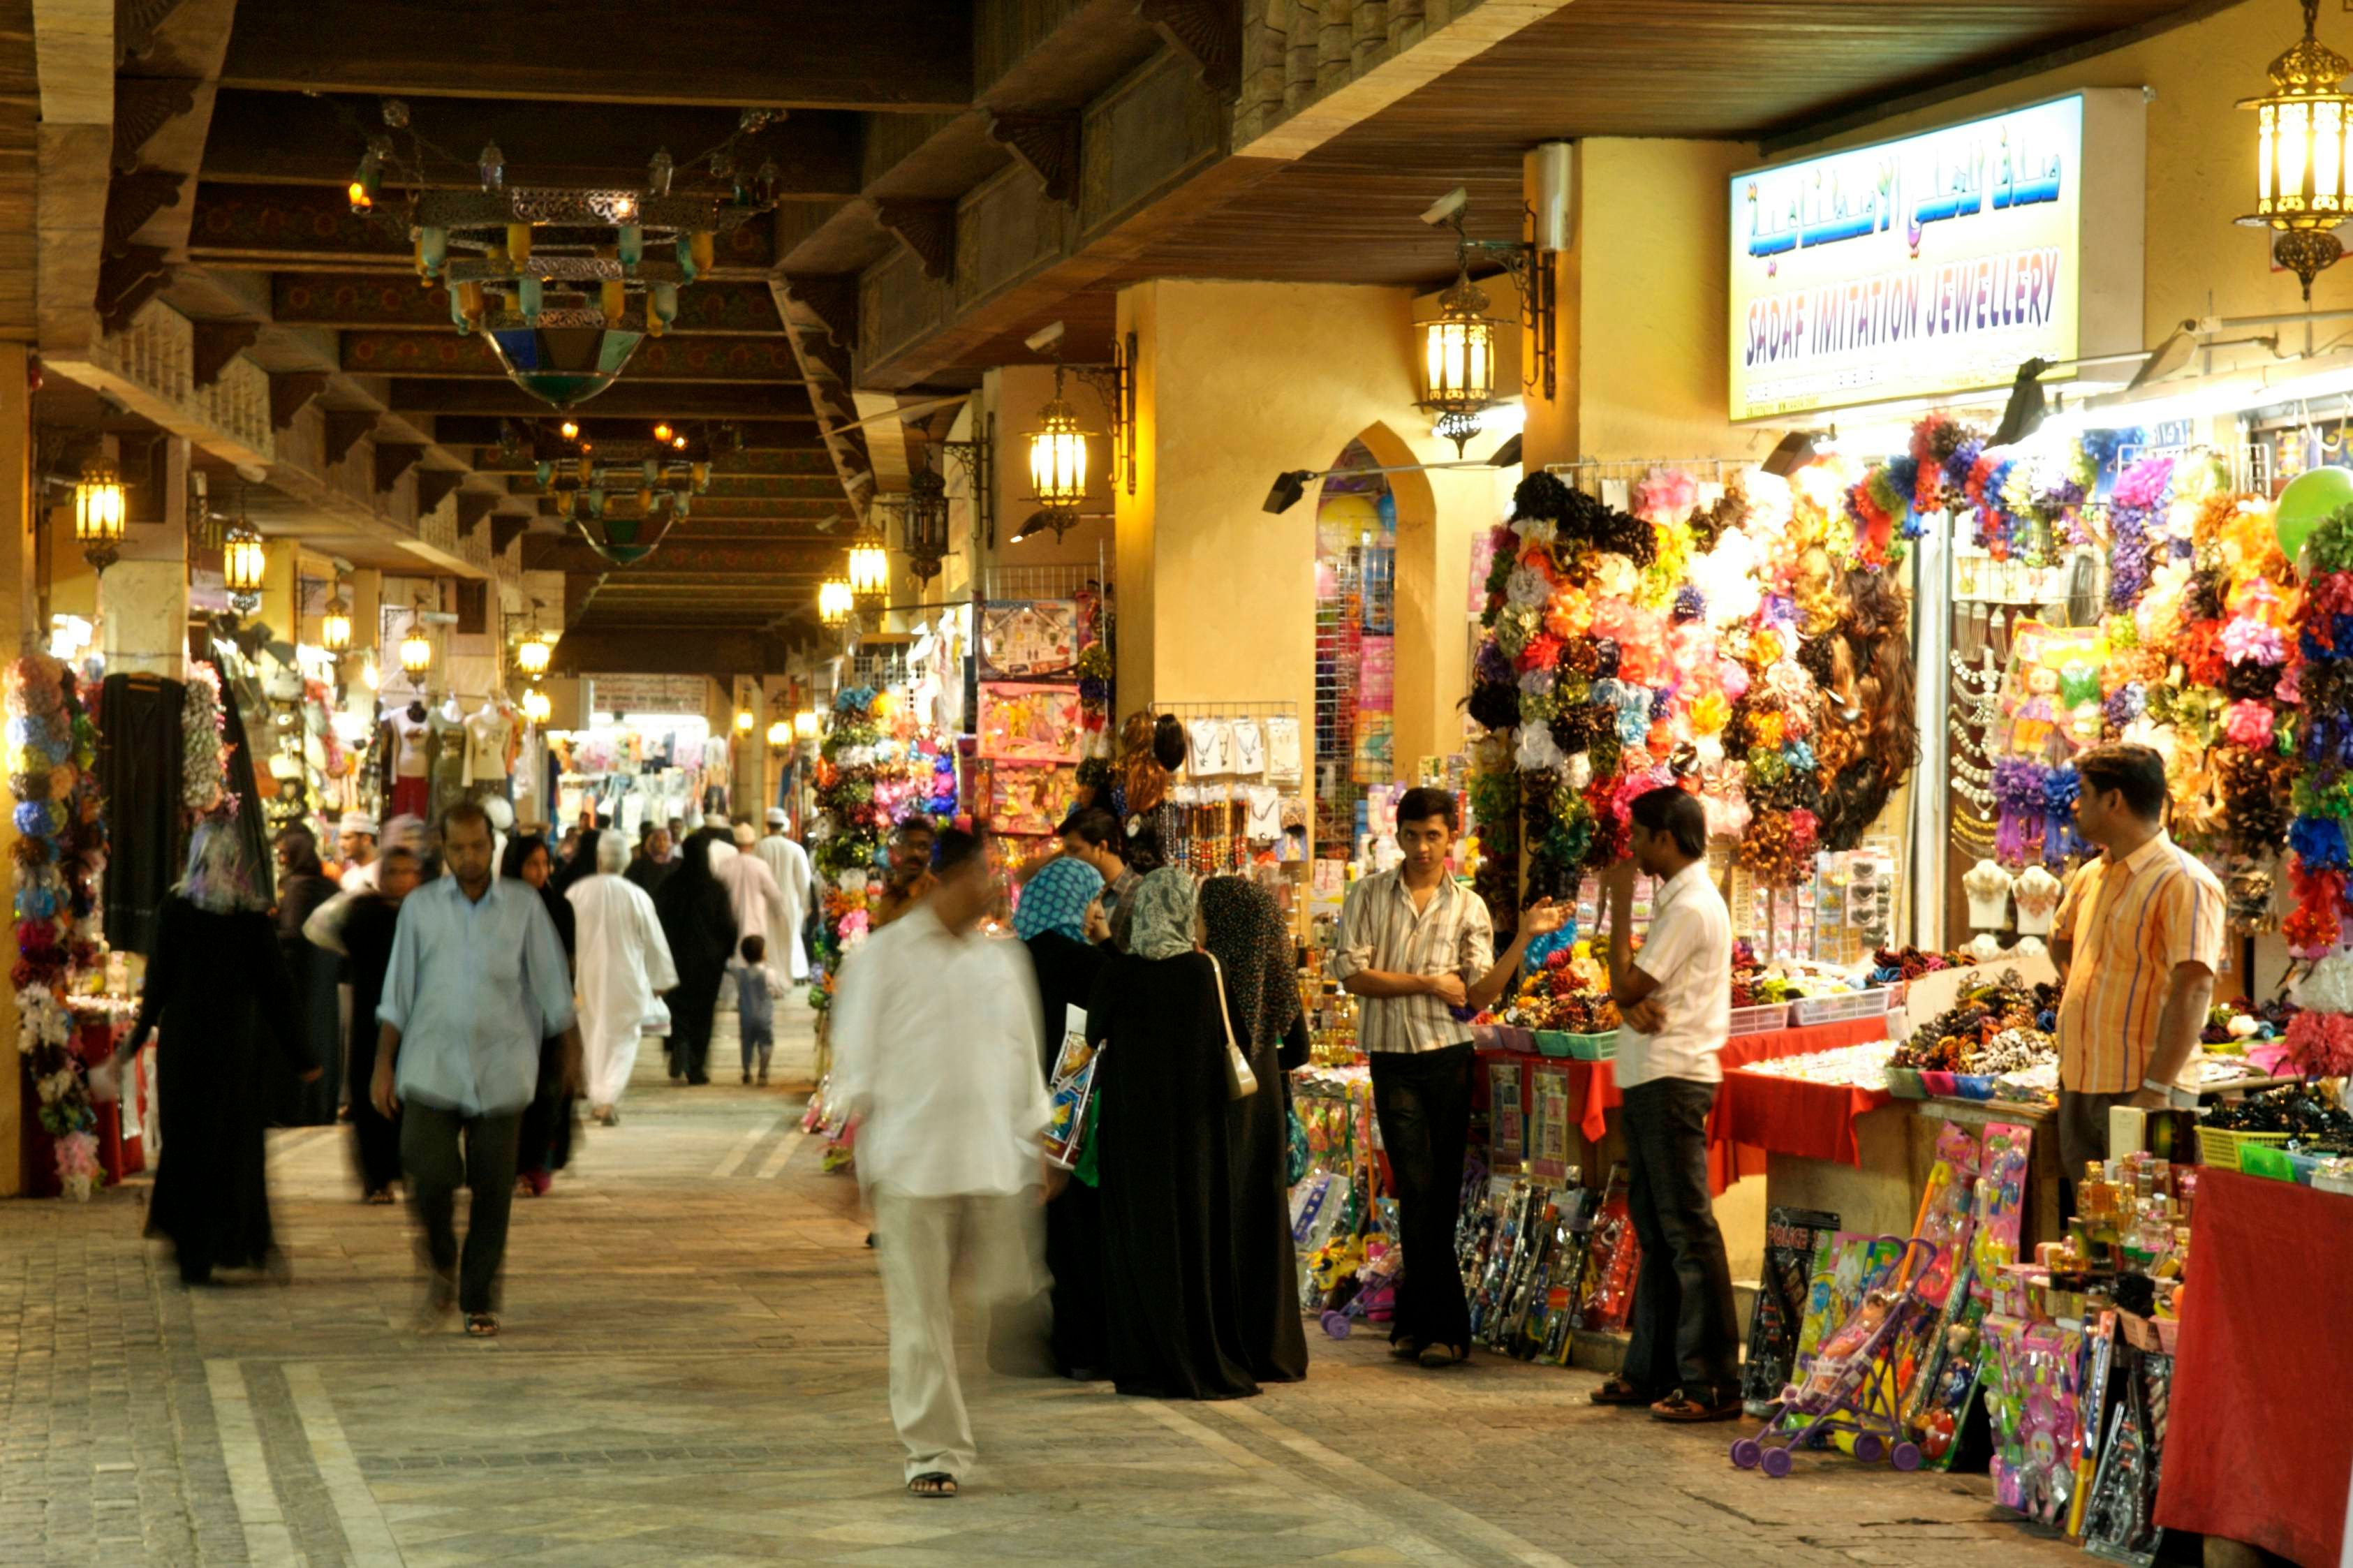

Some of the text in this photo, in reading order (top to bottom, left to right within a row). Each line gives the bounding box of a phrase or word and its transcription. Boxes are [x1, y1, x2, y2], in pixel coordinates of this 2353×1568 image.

[1747, 251, 2058, 367] SADAF IMITATION JEWELLERY
[1768, 1223, 1808, 1250] POLICE
